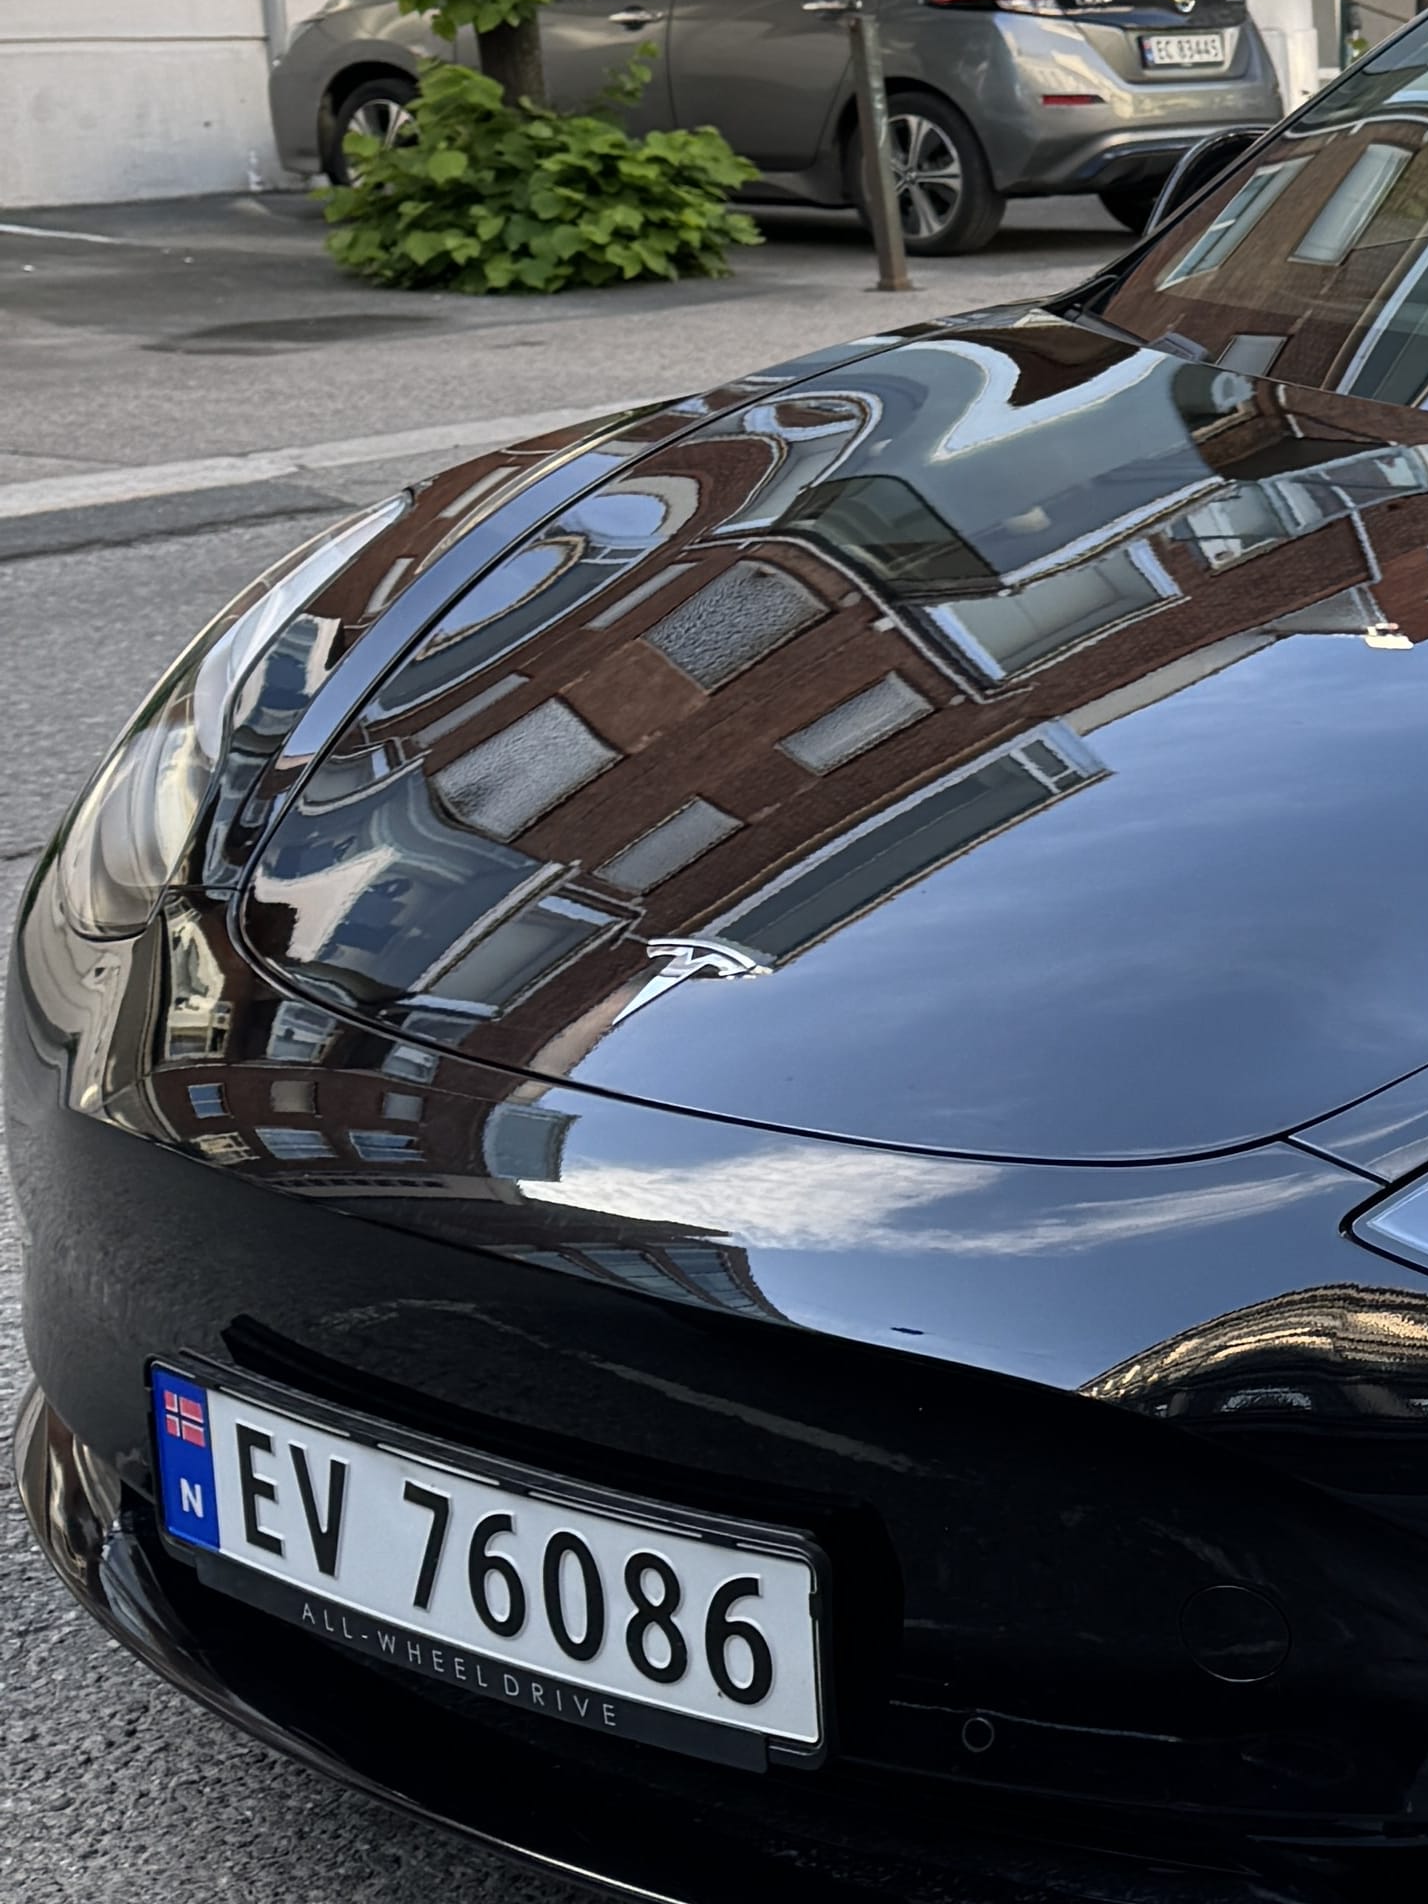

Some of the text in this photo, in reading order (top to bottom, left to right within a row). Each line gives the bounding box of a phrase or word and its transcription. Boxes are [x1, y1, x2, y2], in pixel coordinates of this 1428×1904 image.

[181, 1478, 203, 1518] N
[235, 1420, 774, 1706] EV 76086
